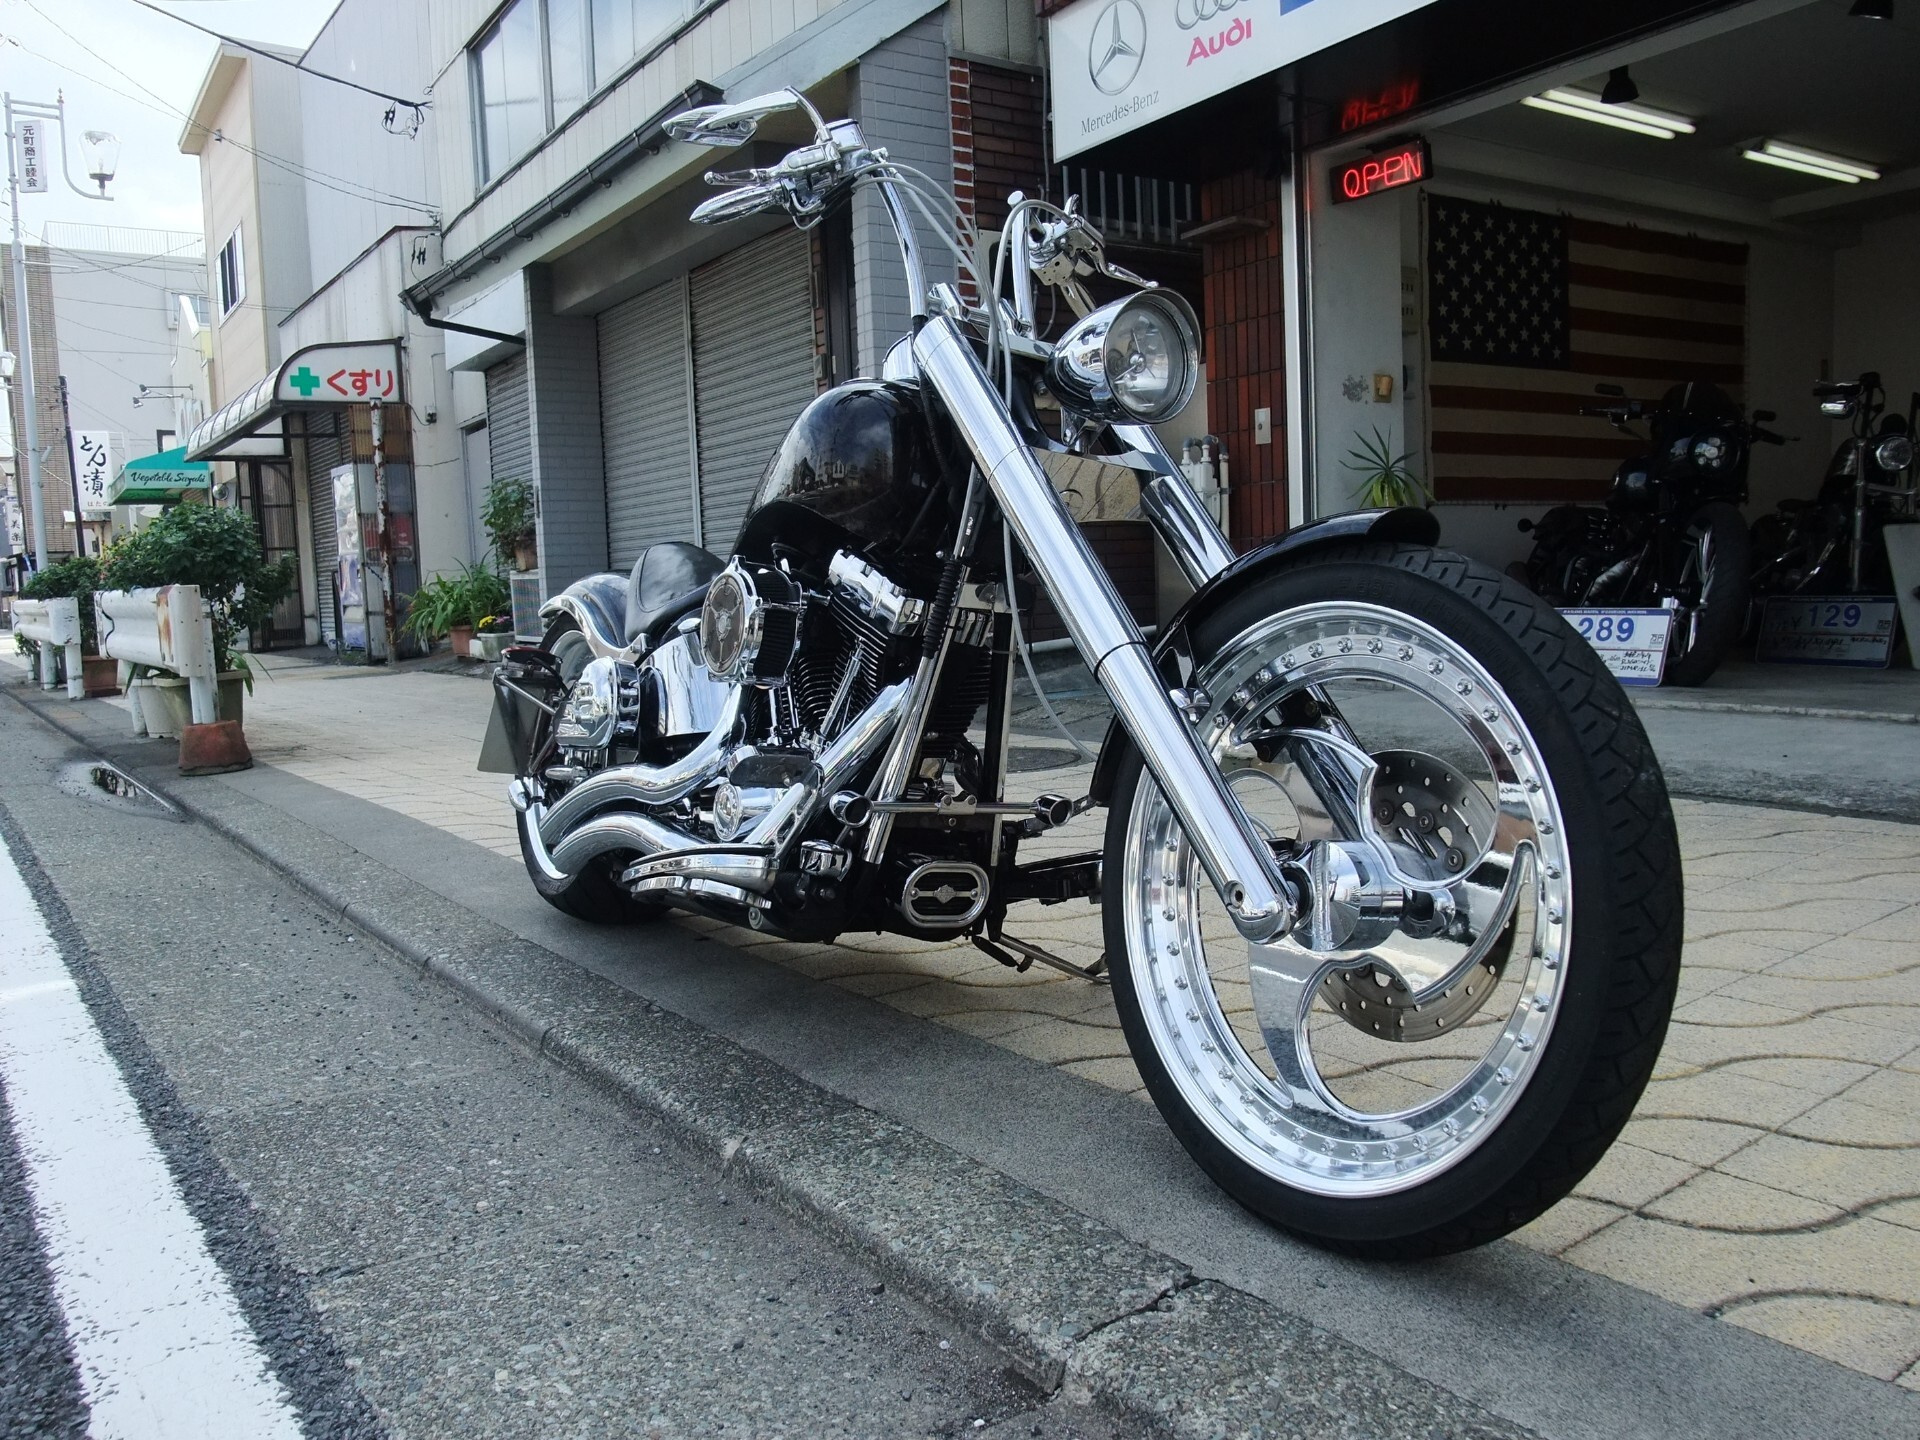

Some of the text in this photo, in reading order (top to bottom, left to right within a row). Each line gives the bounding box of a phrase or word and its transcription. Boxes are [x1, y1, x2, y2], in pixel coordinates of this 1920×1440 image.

[1187, 18, 1252, 67] Audi
[1081, 90, 1160, 136] Mercedes-Benz
[1342, 151, 1423, 198] OPEN
[327, 369, 394, 397] くすり
[80, 435, 107, 498] とん漬
[130, 472, 173, 486] Vegetable
[1578, 617, 1635, 642] 289
[1808, 604, 1862, 627] 129
